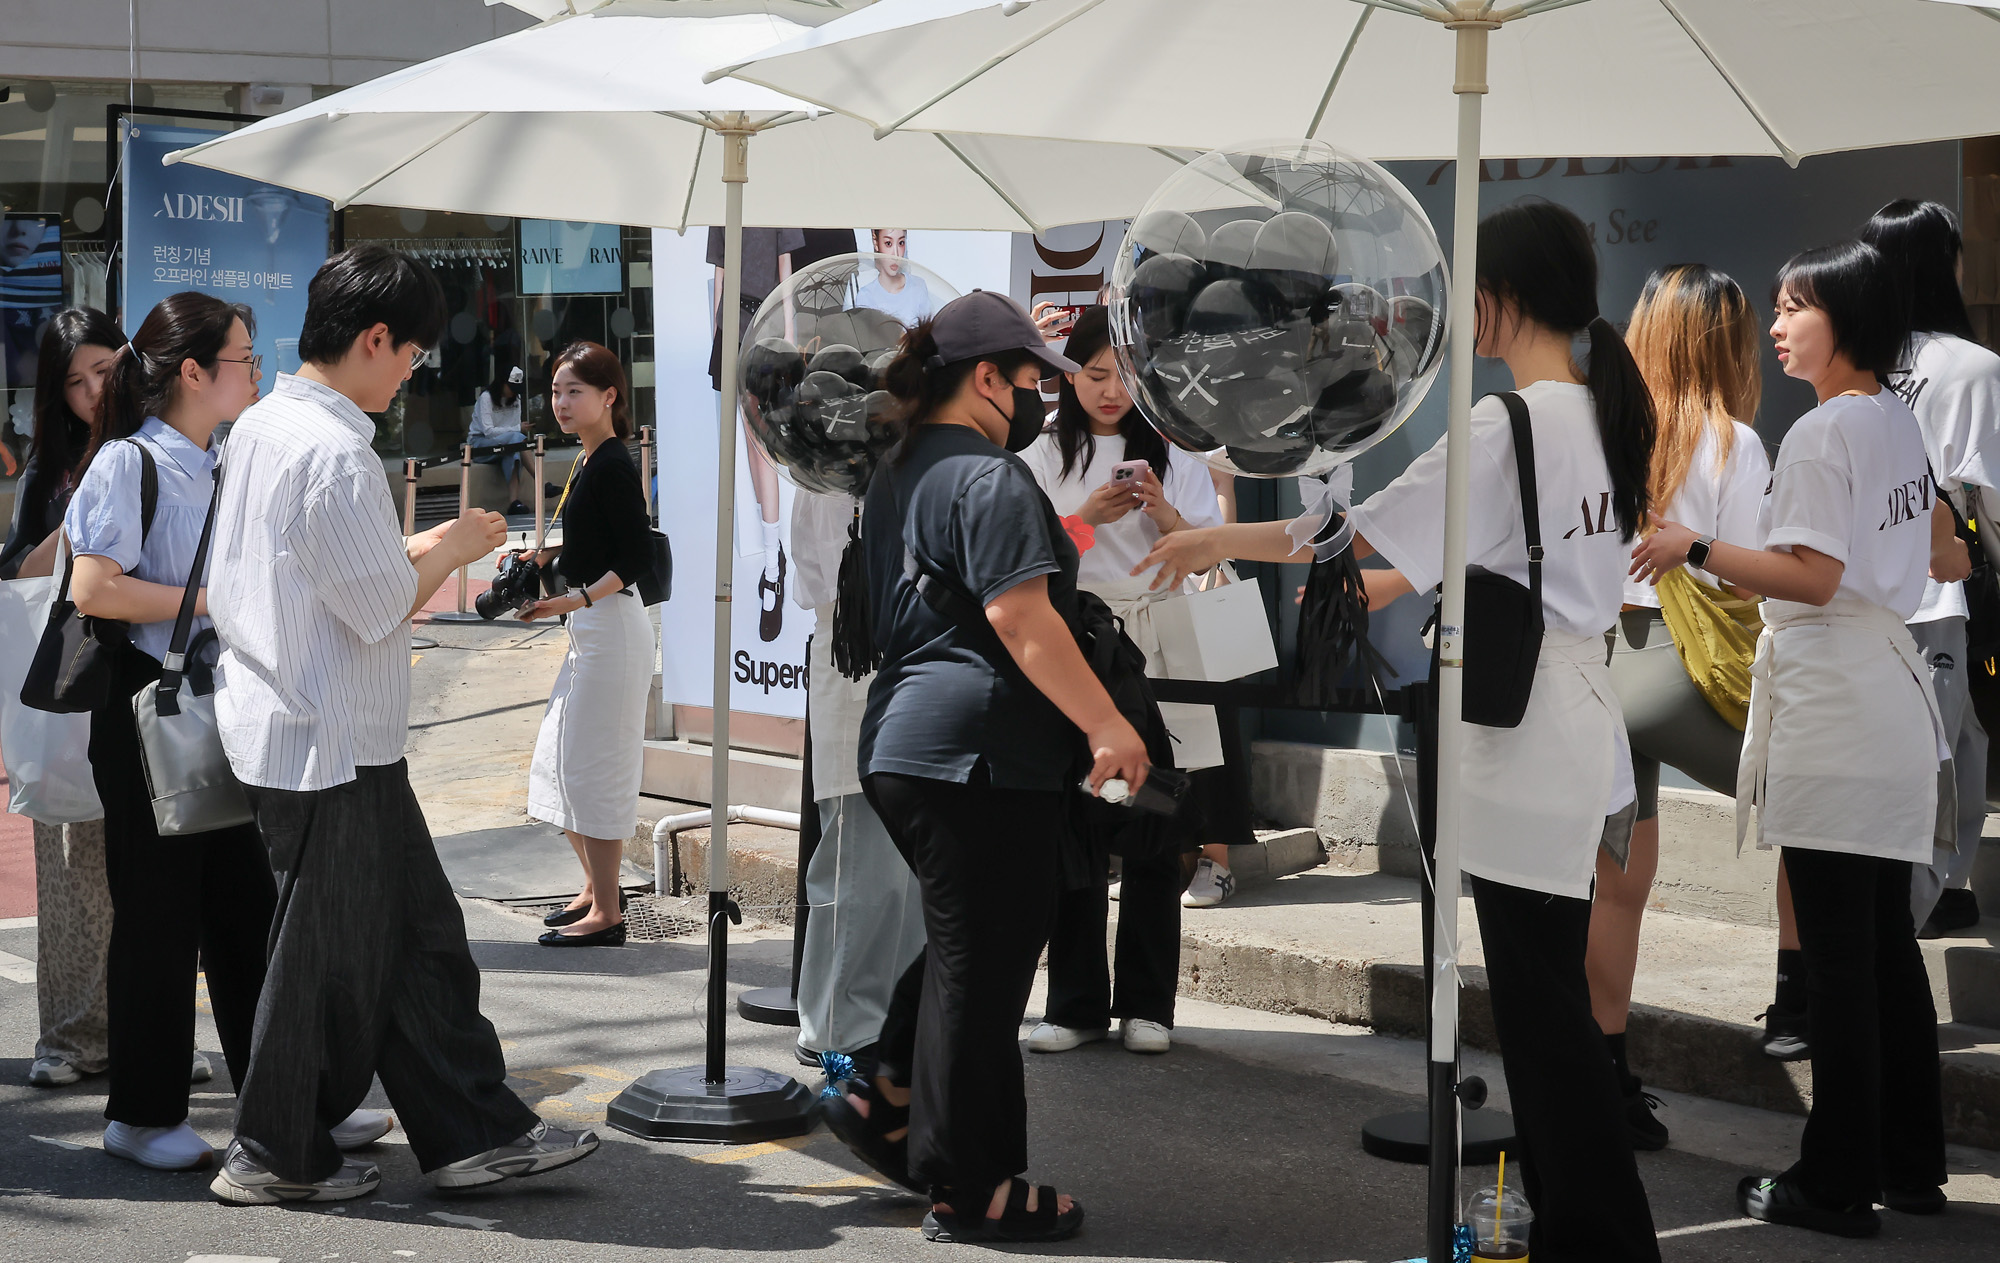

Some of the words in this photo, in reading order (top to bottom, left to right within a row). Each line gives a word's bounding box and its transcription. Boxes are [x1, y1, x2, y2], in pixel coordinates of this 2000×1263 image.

[153, 192, 244, 223] ADESII
[1606, 208, 1659, 245] See
[153, 245, 181, 264] 런칭
[184, 247, 211, 265] 기념
[153, 267, 207, 286] 오프라인
[210, 269, 250, 288] 샘플링
[253, 271, 293, 290] 이벤트
